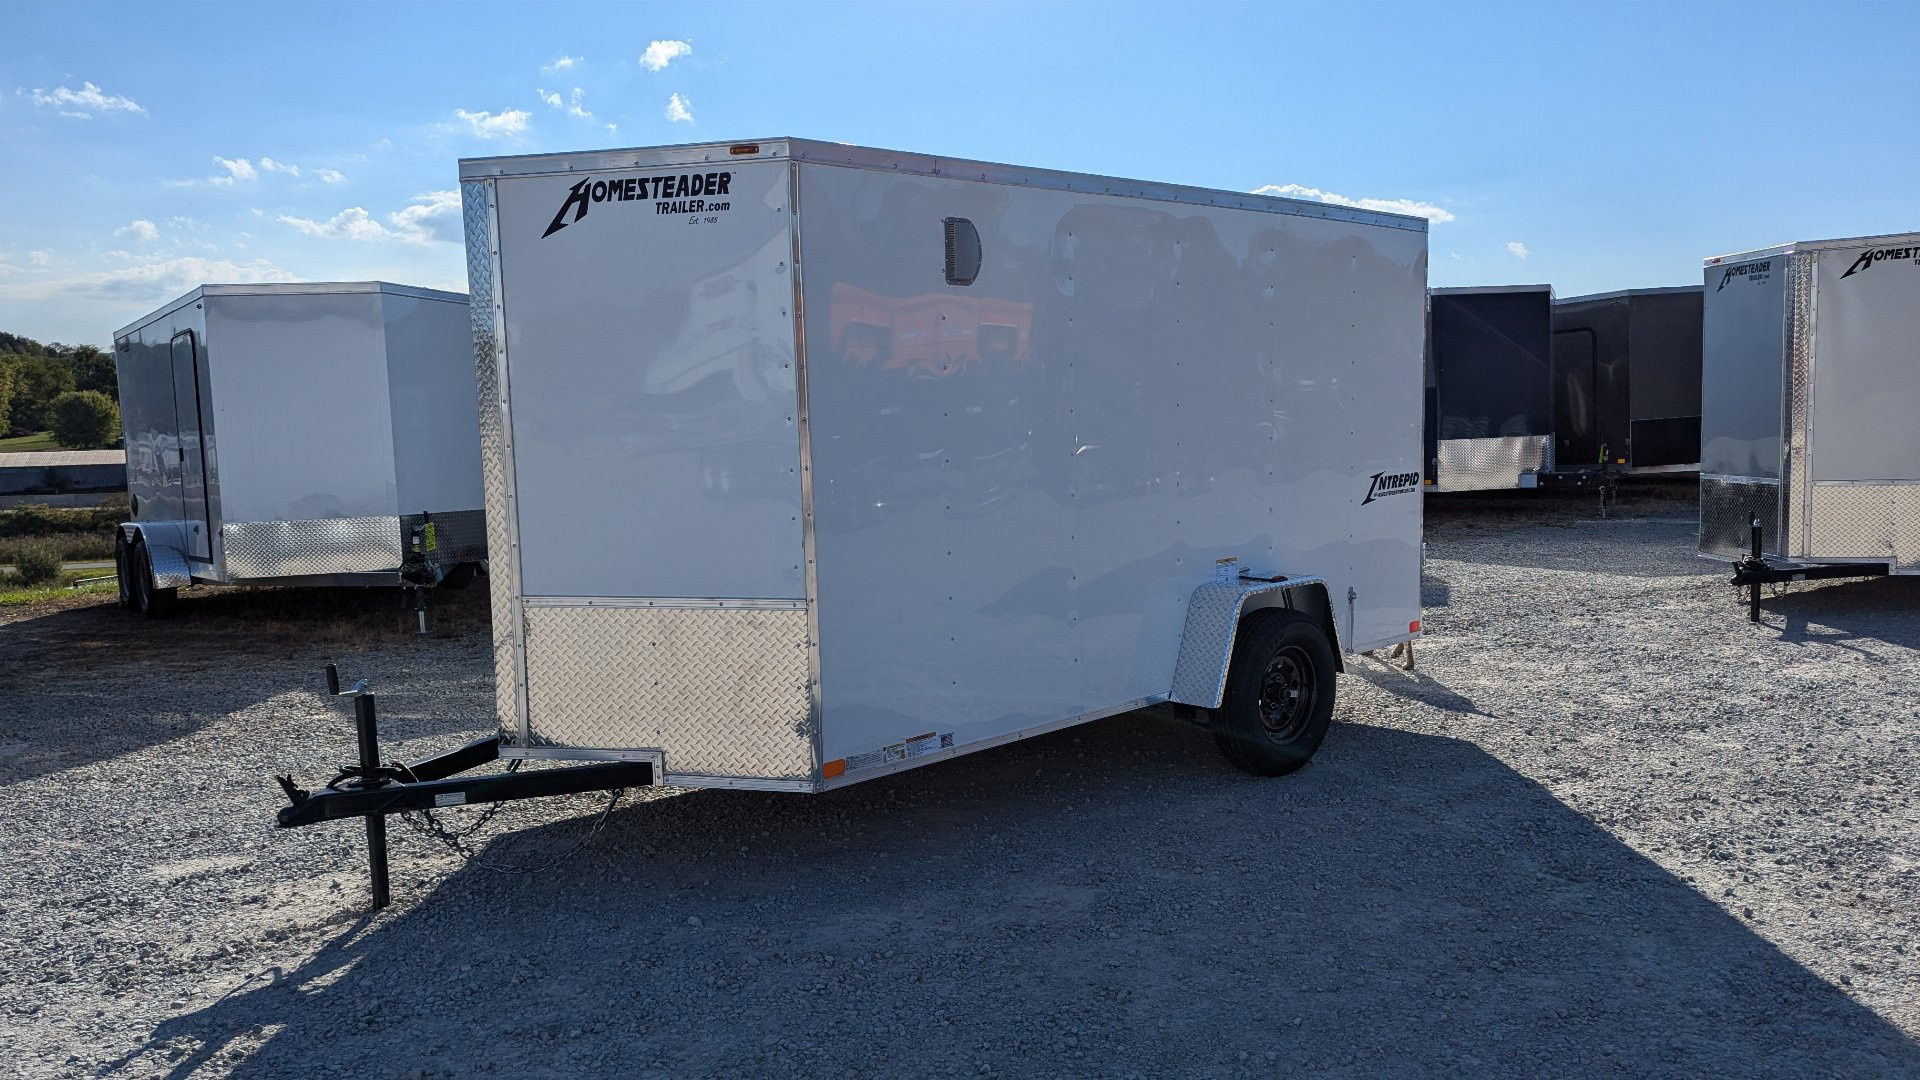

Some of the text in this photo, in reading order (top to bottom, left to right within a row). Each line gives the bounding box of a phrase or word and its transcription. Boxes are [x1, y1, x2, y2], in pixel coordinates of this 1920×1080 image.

[541, 172, 732, 239] HOMESTEADER
[655, 199, 731, 215] TRAILER.com
[1839, 246, 1920, 280] HOMEST
[1361, 470, 1420, 506] INTREPID
